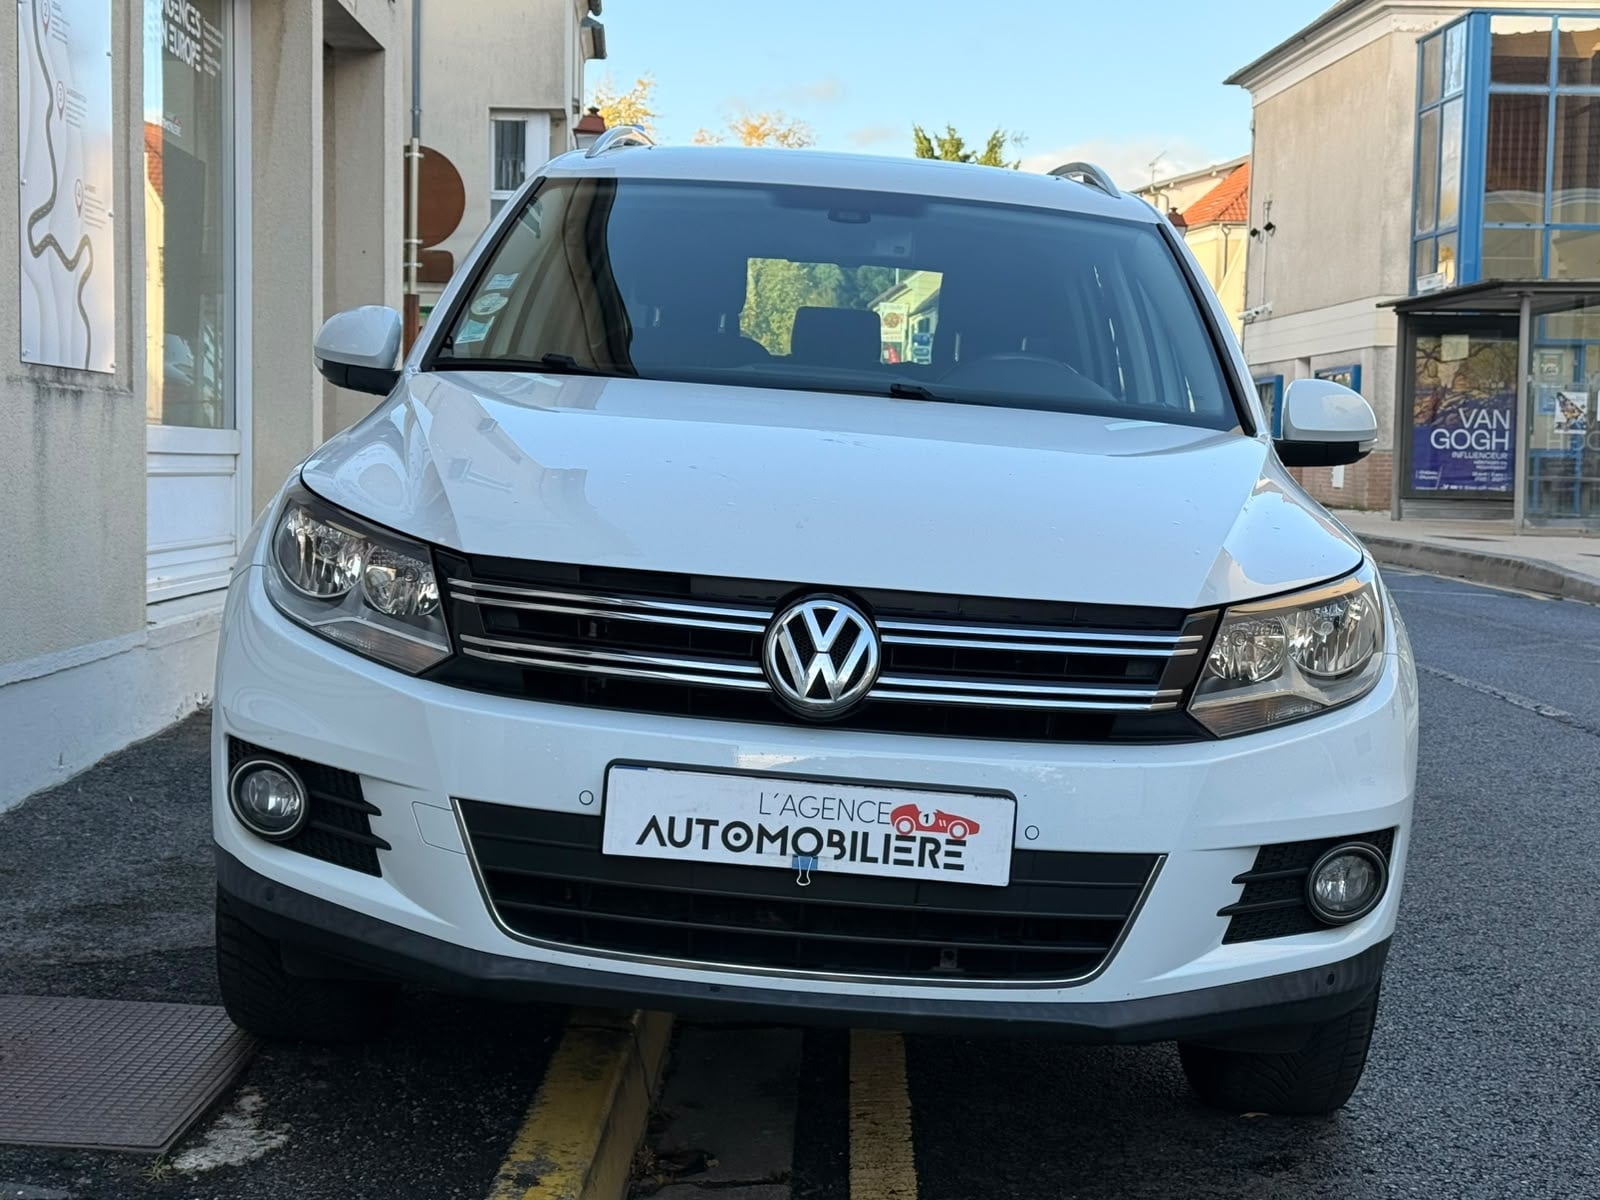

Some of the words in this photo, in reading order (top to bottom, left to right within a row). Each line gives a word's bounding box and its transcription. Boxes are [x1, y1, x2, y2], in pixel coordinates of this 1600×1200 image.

[169, 23, 201, 72] EUROPE
[1459, 408, 1510, 429] VAN
[1430, 428, 1509, 451] GOGH
[1451, 451, 1508, 460] INFLUENCEUR
[770, 599, 874, 703] VW
[759, 792, 892, 825] L'AGENCE
[923, 813, 929, 824] 1
